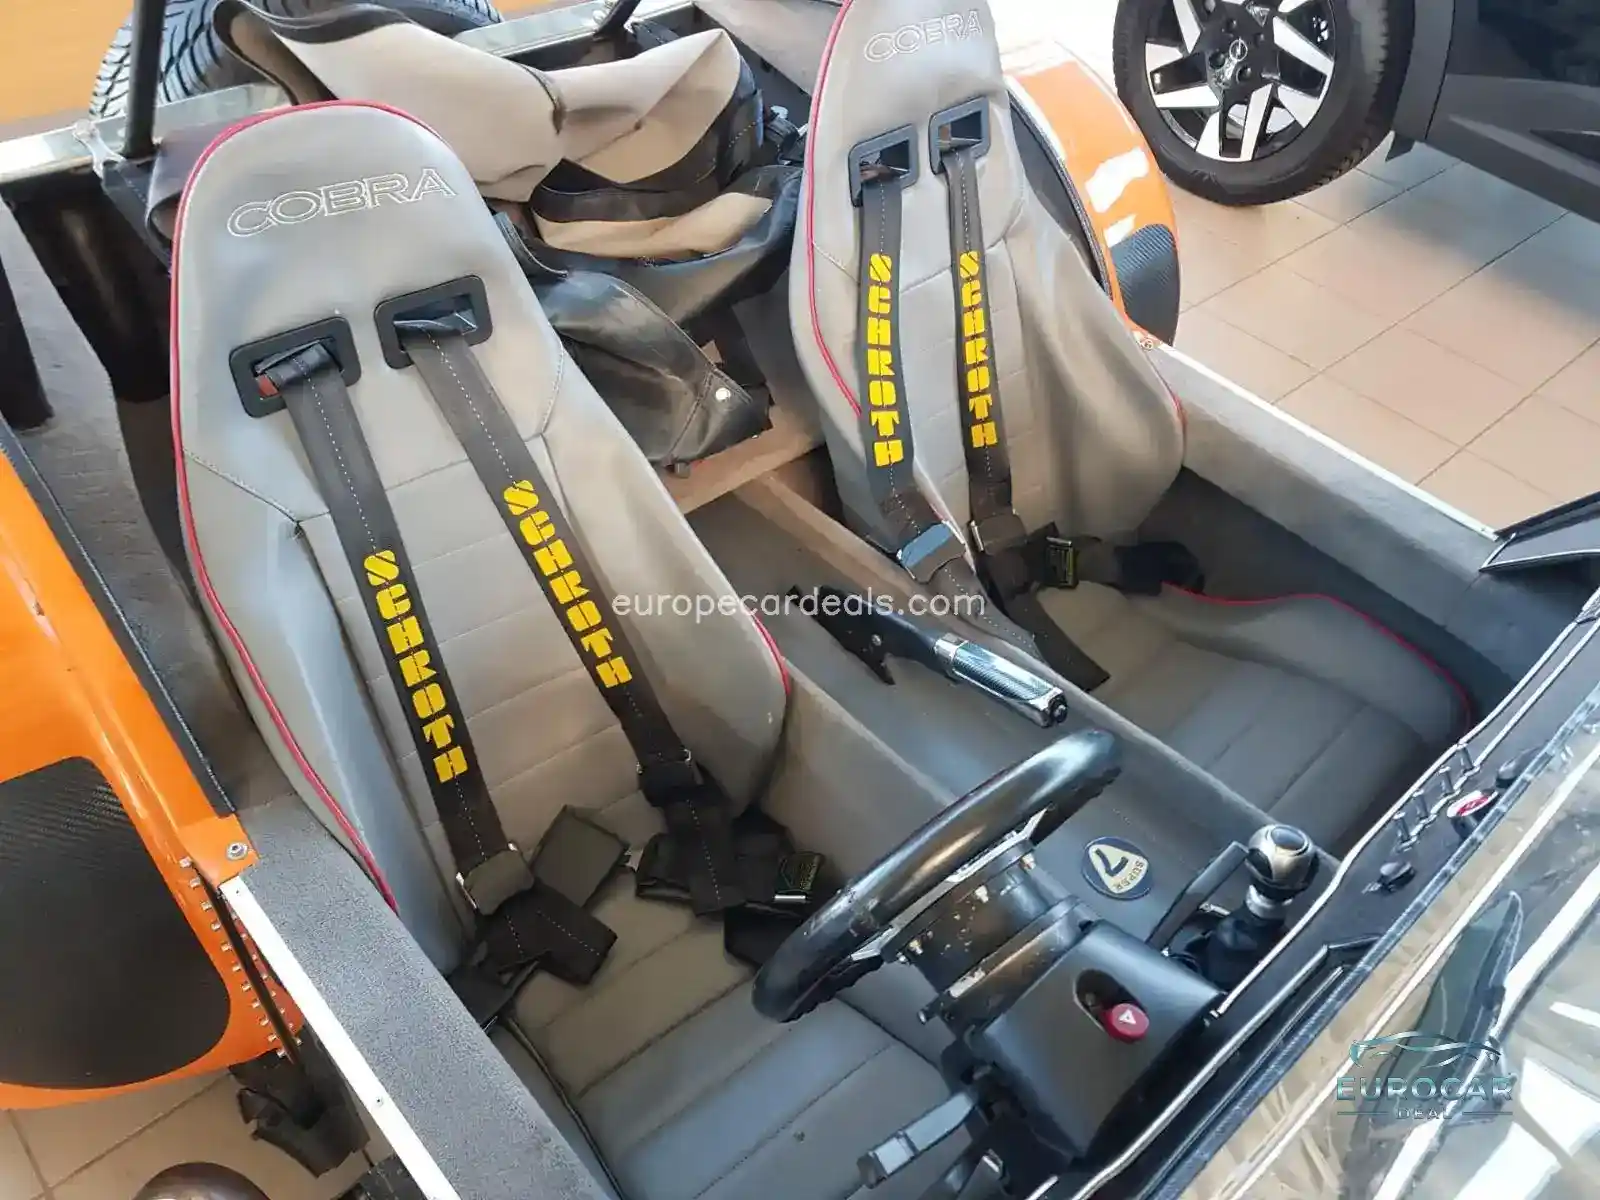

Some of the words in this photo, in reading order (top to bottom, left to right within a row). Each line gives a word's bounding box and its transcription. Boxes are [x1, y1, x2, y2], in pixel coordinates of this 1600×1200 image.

[864, 9, 984, 63] COBRA
[227, 168, 457, 237] COBRA
[867, 253, 904, 467] SCHROTH
[959, 251, 998, 448] SCHROTH
[503, 479, 633, 688] SCHROTH
[363, 550, 468, 783] SCHROTH
[1095, 848, 1129, 877] 7
[1113, 860, 1144, 890] SUPER
